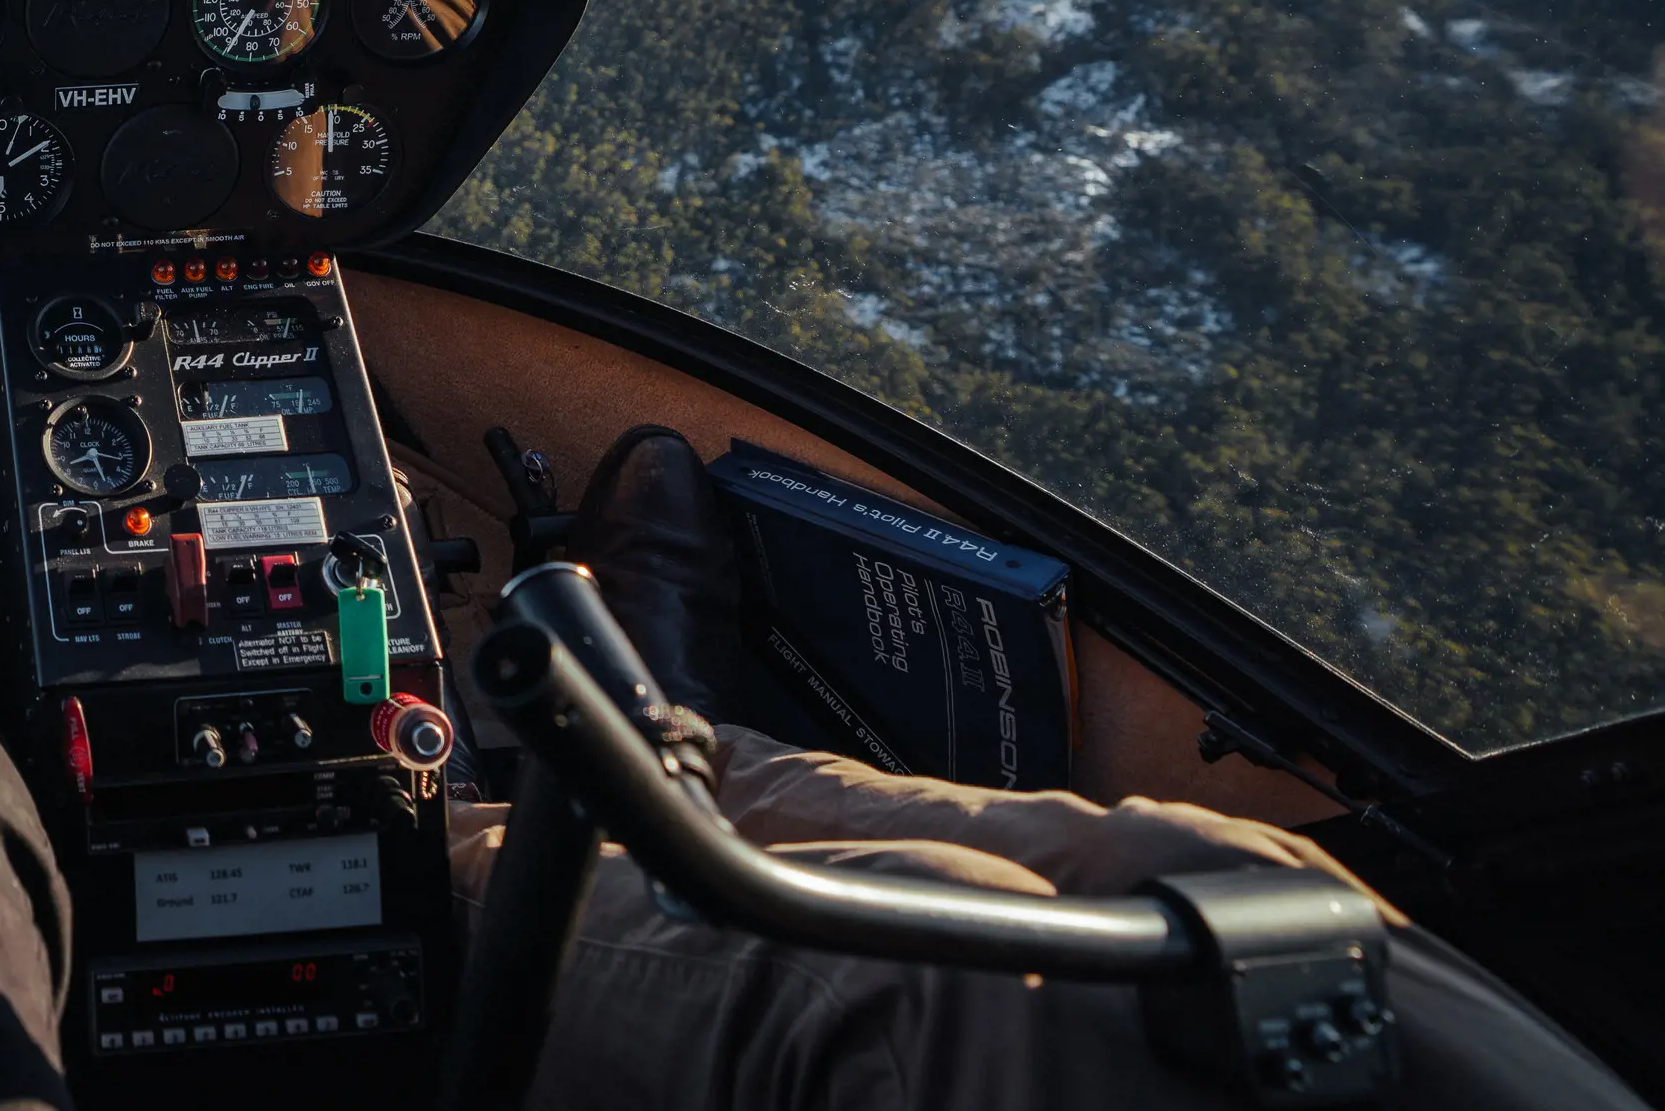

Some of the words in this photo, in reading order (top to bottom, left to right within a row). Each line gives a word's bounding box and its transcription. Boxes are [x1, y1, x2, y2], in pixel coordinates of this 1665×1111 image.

[296, 0, 310, 9] 50
[204, 12, 217, 22] 110
[285, 21, 299, 31] 60
[391, 33, 398, 41] %
[400, 32, 421, 41] RPM
[245, 42, 259, 51] 80
[268, 37, 280, 47] 70
[58, 87, 137, 108] VH-EHV
[361, 140, 376, 149] 30
[359, 165, 372, 175] 35
[311, 190, 342, 198] CAUTION
[115, 240, 143, 248] EXCEED
[155, 238, 171, 246] KIAS
[171, 237, 197, 245] EXCEPT
[257, 282, 275, 290] FIRE
[64, 334, 96, 343] HOURS
[173, 352, 225, 372] R44
[232, 351, 303, 370] Clipper
[303, 346, 320, 362] II
[285, 480, 300, 488] 200
[747, 468, 848, 508] Handbook
[853, 502, 923, 535] Pilot's
[923, 527, 943, 541] II
[127, 539, 155, 548] BRAKE
[941, 534, 999, 562] R44
[235, 596, 251, 605] OFF
[277, 593, 293, 603] OFF
[895, 568, 927, 636] Pilot's
[76, 606, 92, 616] OFF
[118, 603, 134, 612] OFF
[852, 551, 890, 665] Handbook
[874, 560, 911, 674] Operating
[241, 624, 253, 632] ALT
[276, 621, 303, 629] MASTER
[939, 584, 981, 662] R44
[75, 635, 89, 643] NAV
[88, 634, 101, 642] LTS
[116, 632, 141, 641] STROBE
[238, 638, 275, 648] Alternator
[278, 636, 297, 644] NOT
[299, 635, 309, 643] to
[311, 634, 322, 642] be
[239, 647, 275, 658] Switched
[278, 645, 289, 654] off
[291, 645, 300, 653] in
[302, 643, 325, 654] Flight
[241, 657, 269, 668] Except
[271, 656, 281, 664] in
[282, 654, 326, 665] Emergency
[767, 633, 808, 676] FLIGHT
[807, 674, 852, 728] MANUAL
[289, 862, 312, 874] TWR
[155, 872, 178, 883] ATIS
[289, 887, 315, 900] CTAF
[156, 896, 195, 908] Ground
